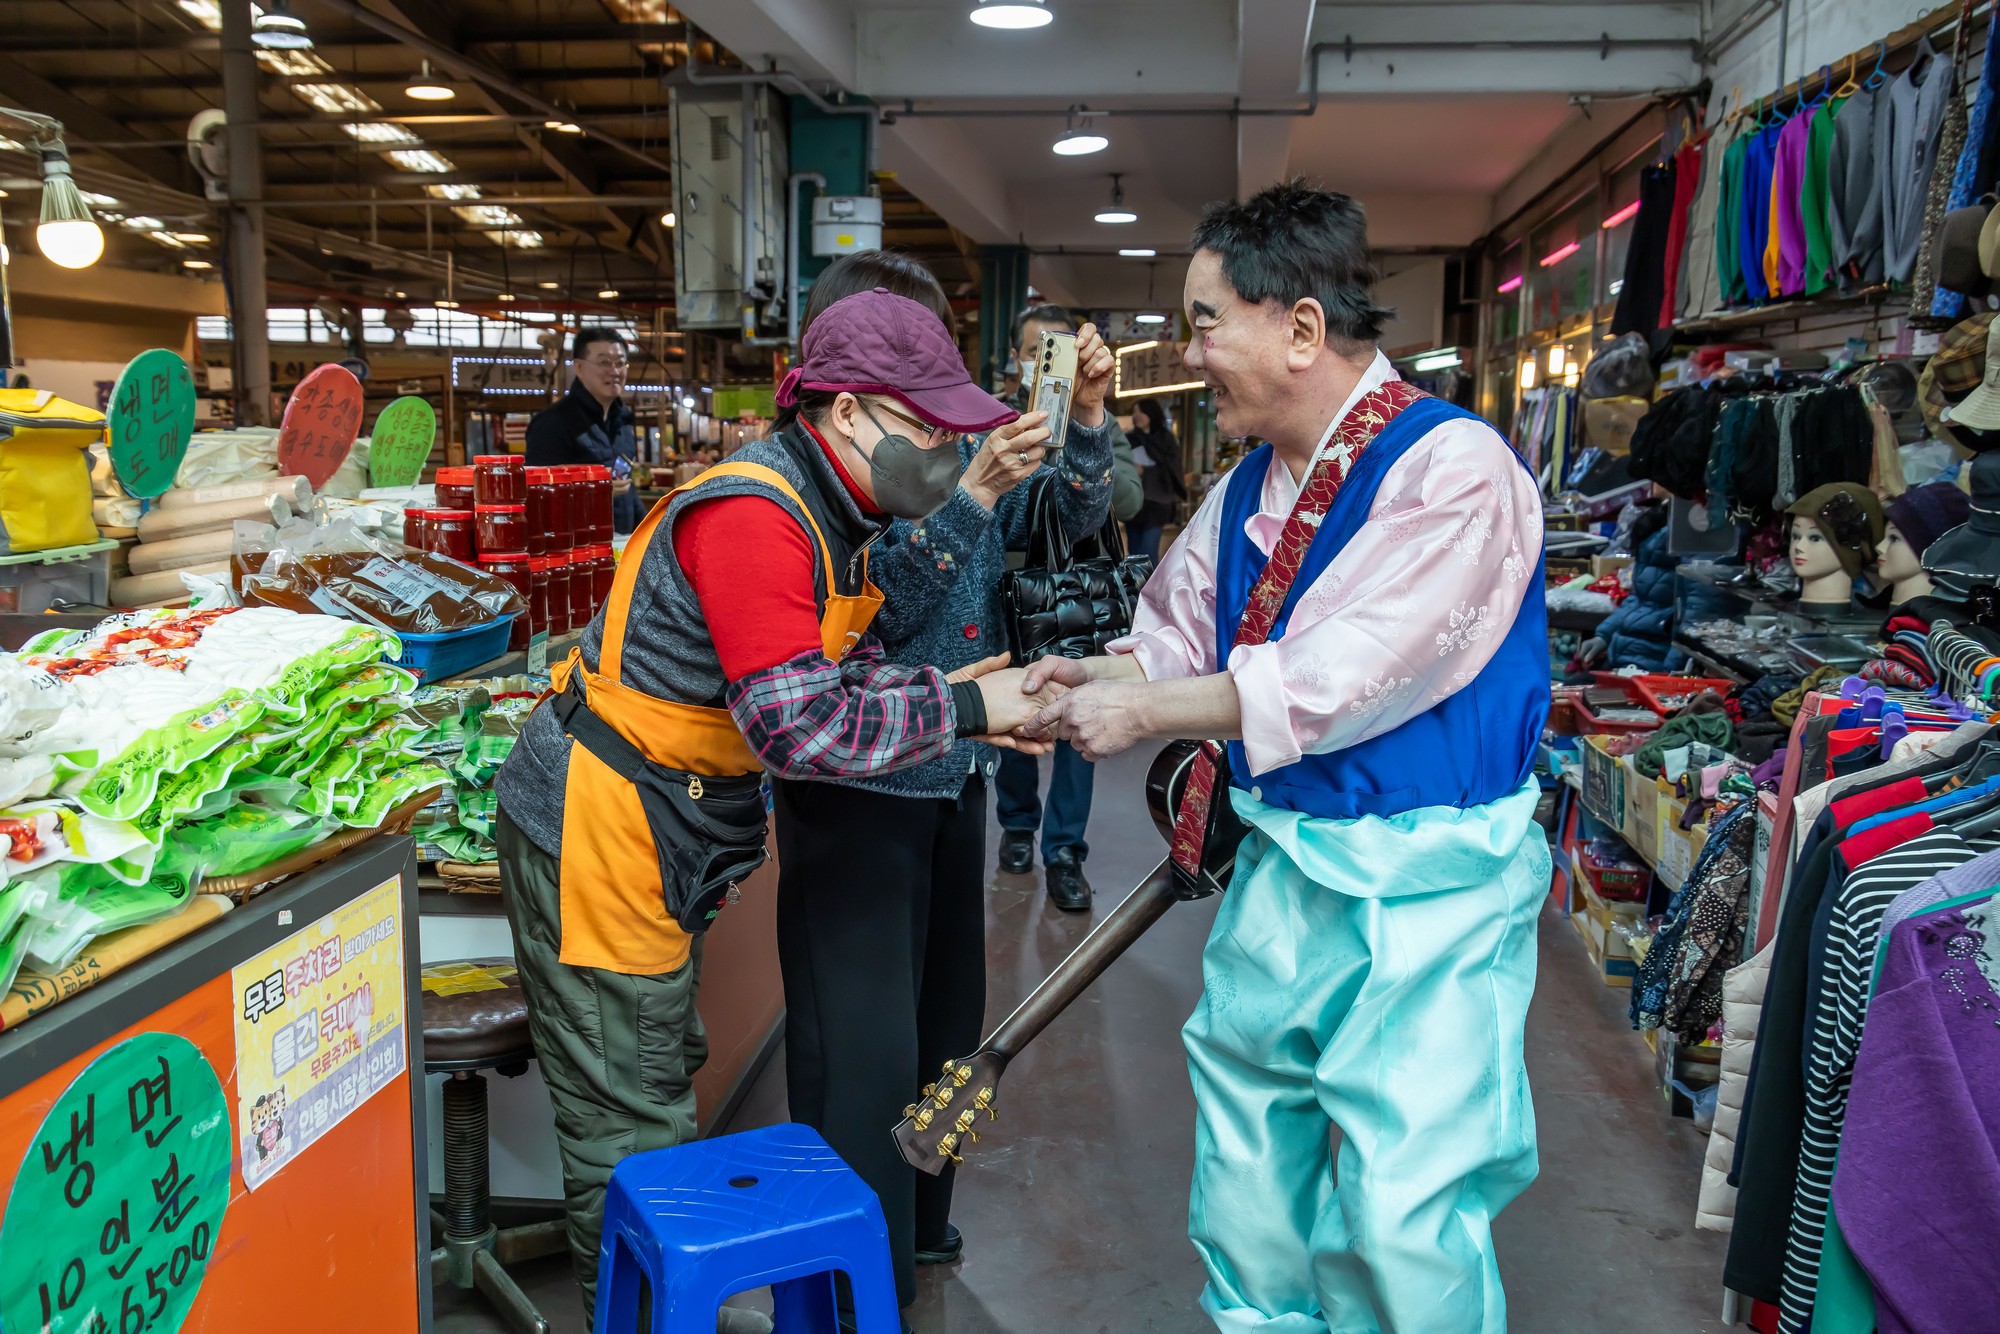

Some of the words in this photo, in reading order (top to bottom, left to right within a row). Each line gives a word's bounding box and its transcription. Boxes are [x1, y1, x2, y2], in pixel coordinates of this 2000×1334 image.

[244, 968, 286, 1024] 무료
[285, 934, 343, 999] 주차권
[344, 915, 396, 964] 받아가세요
[271, 1007, 319, 1079] 물건
[300, 1041, 398, 1138] 인왕시장상인회
[41, 1055, 182, 1208] 냉면
